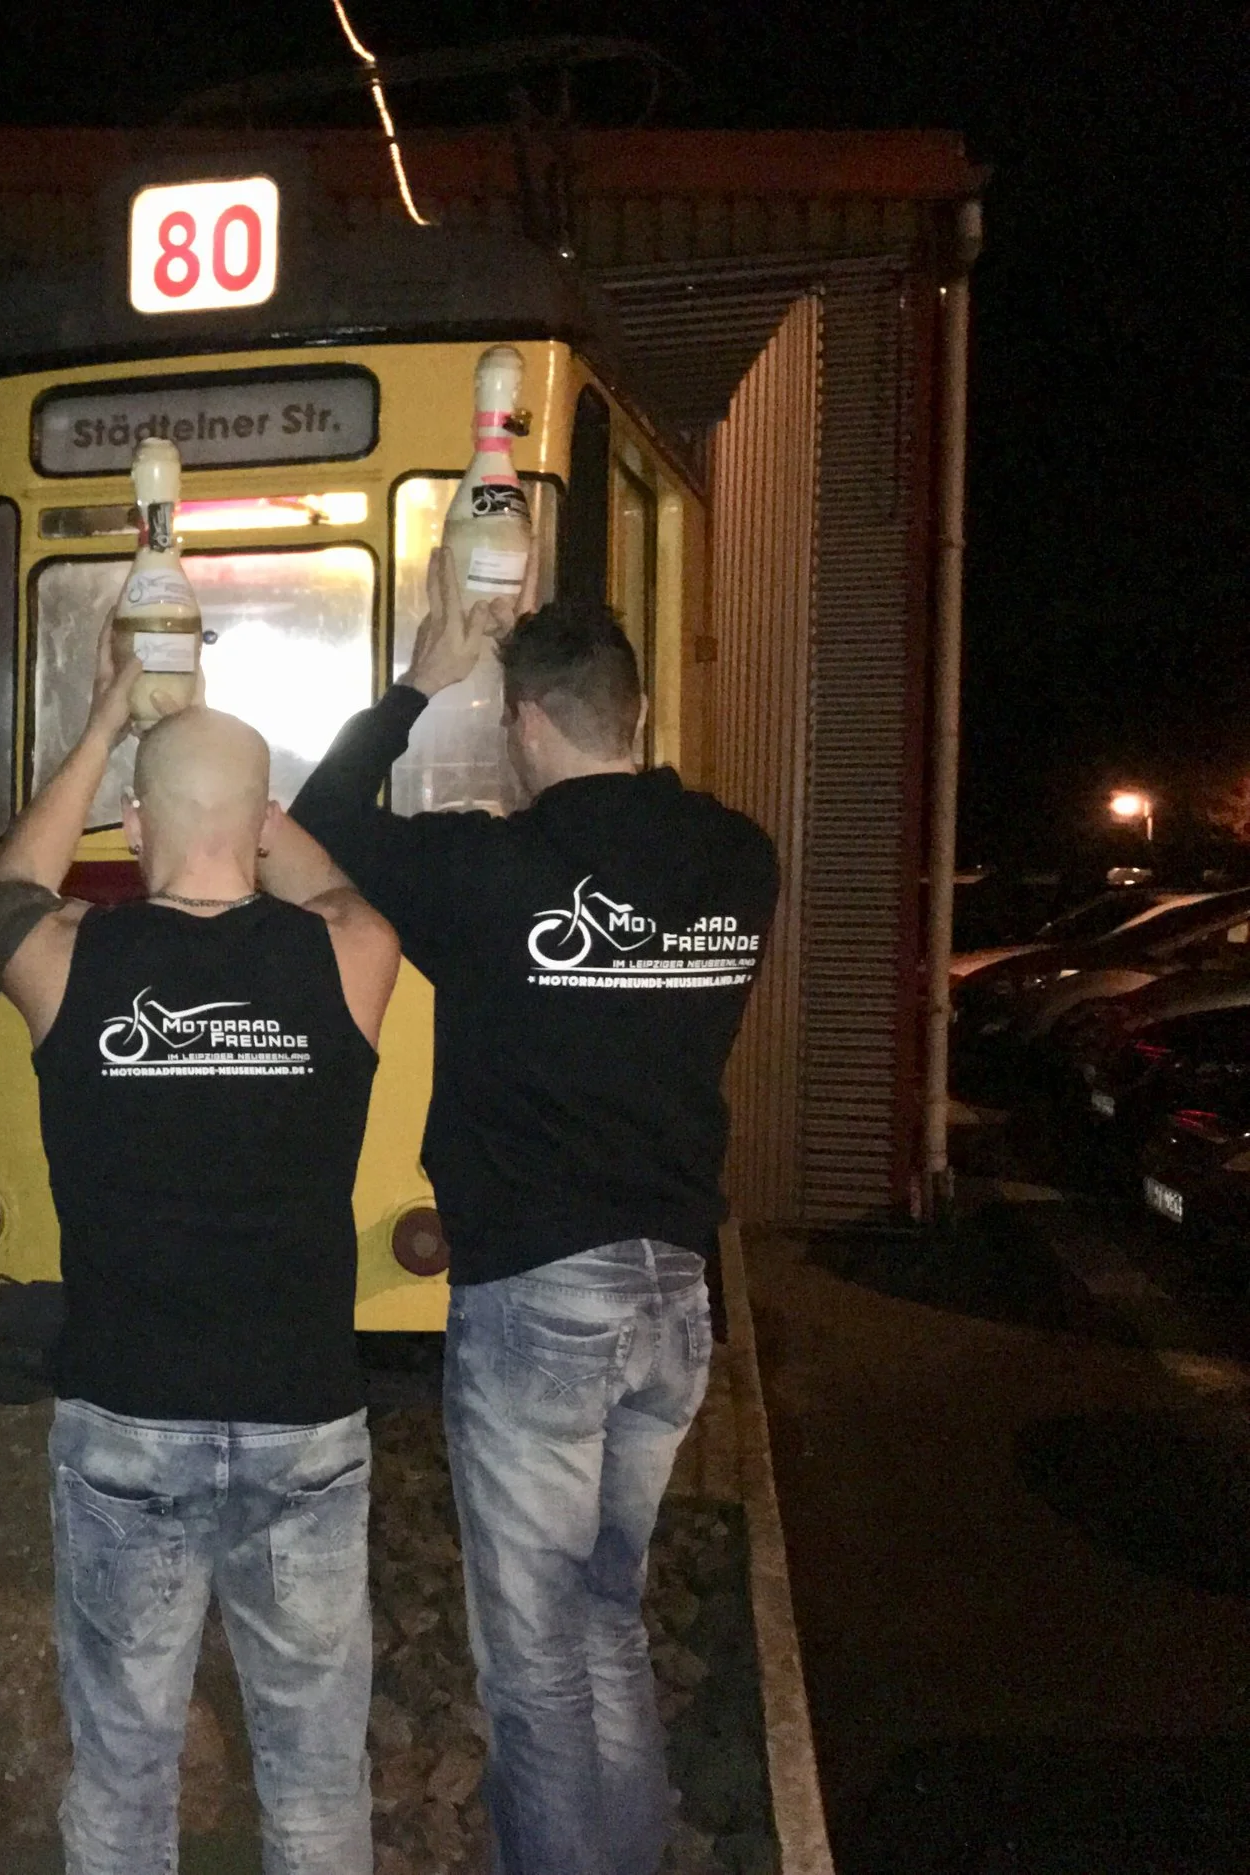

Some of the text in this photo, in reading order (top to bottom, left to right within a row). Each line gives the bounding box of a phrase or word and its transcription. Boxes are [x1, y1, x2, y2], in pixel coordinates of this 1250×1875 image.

[153, 203, 262, 298] 80
[281, 402, 342, 435] Str.
[662, 932, 760, 952] FREUNDE
[612, 959, 625, 968] IM
[162, 1017, 281, 1034] MOTORRAD
[211, 1032, 309, 1048] FREUNDE
